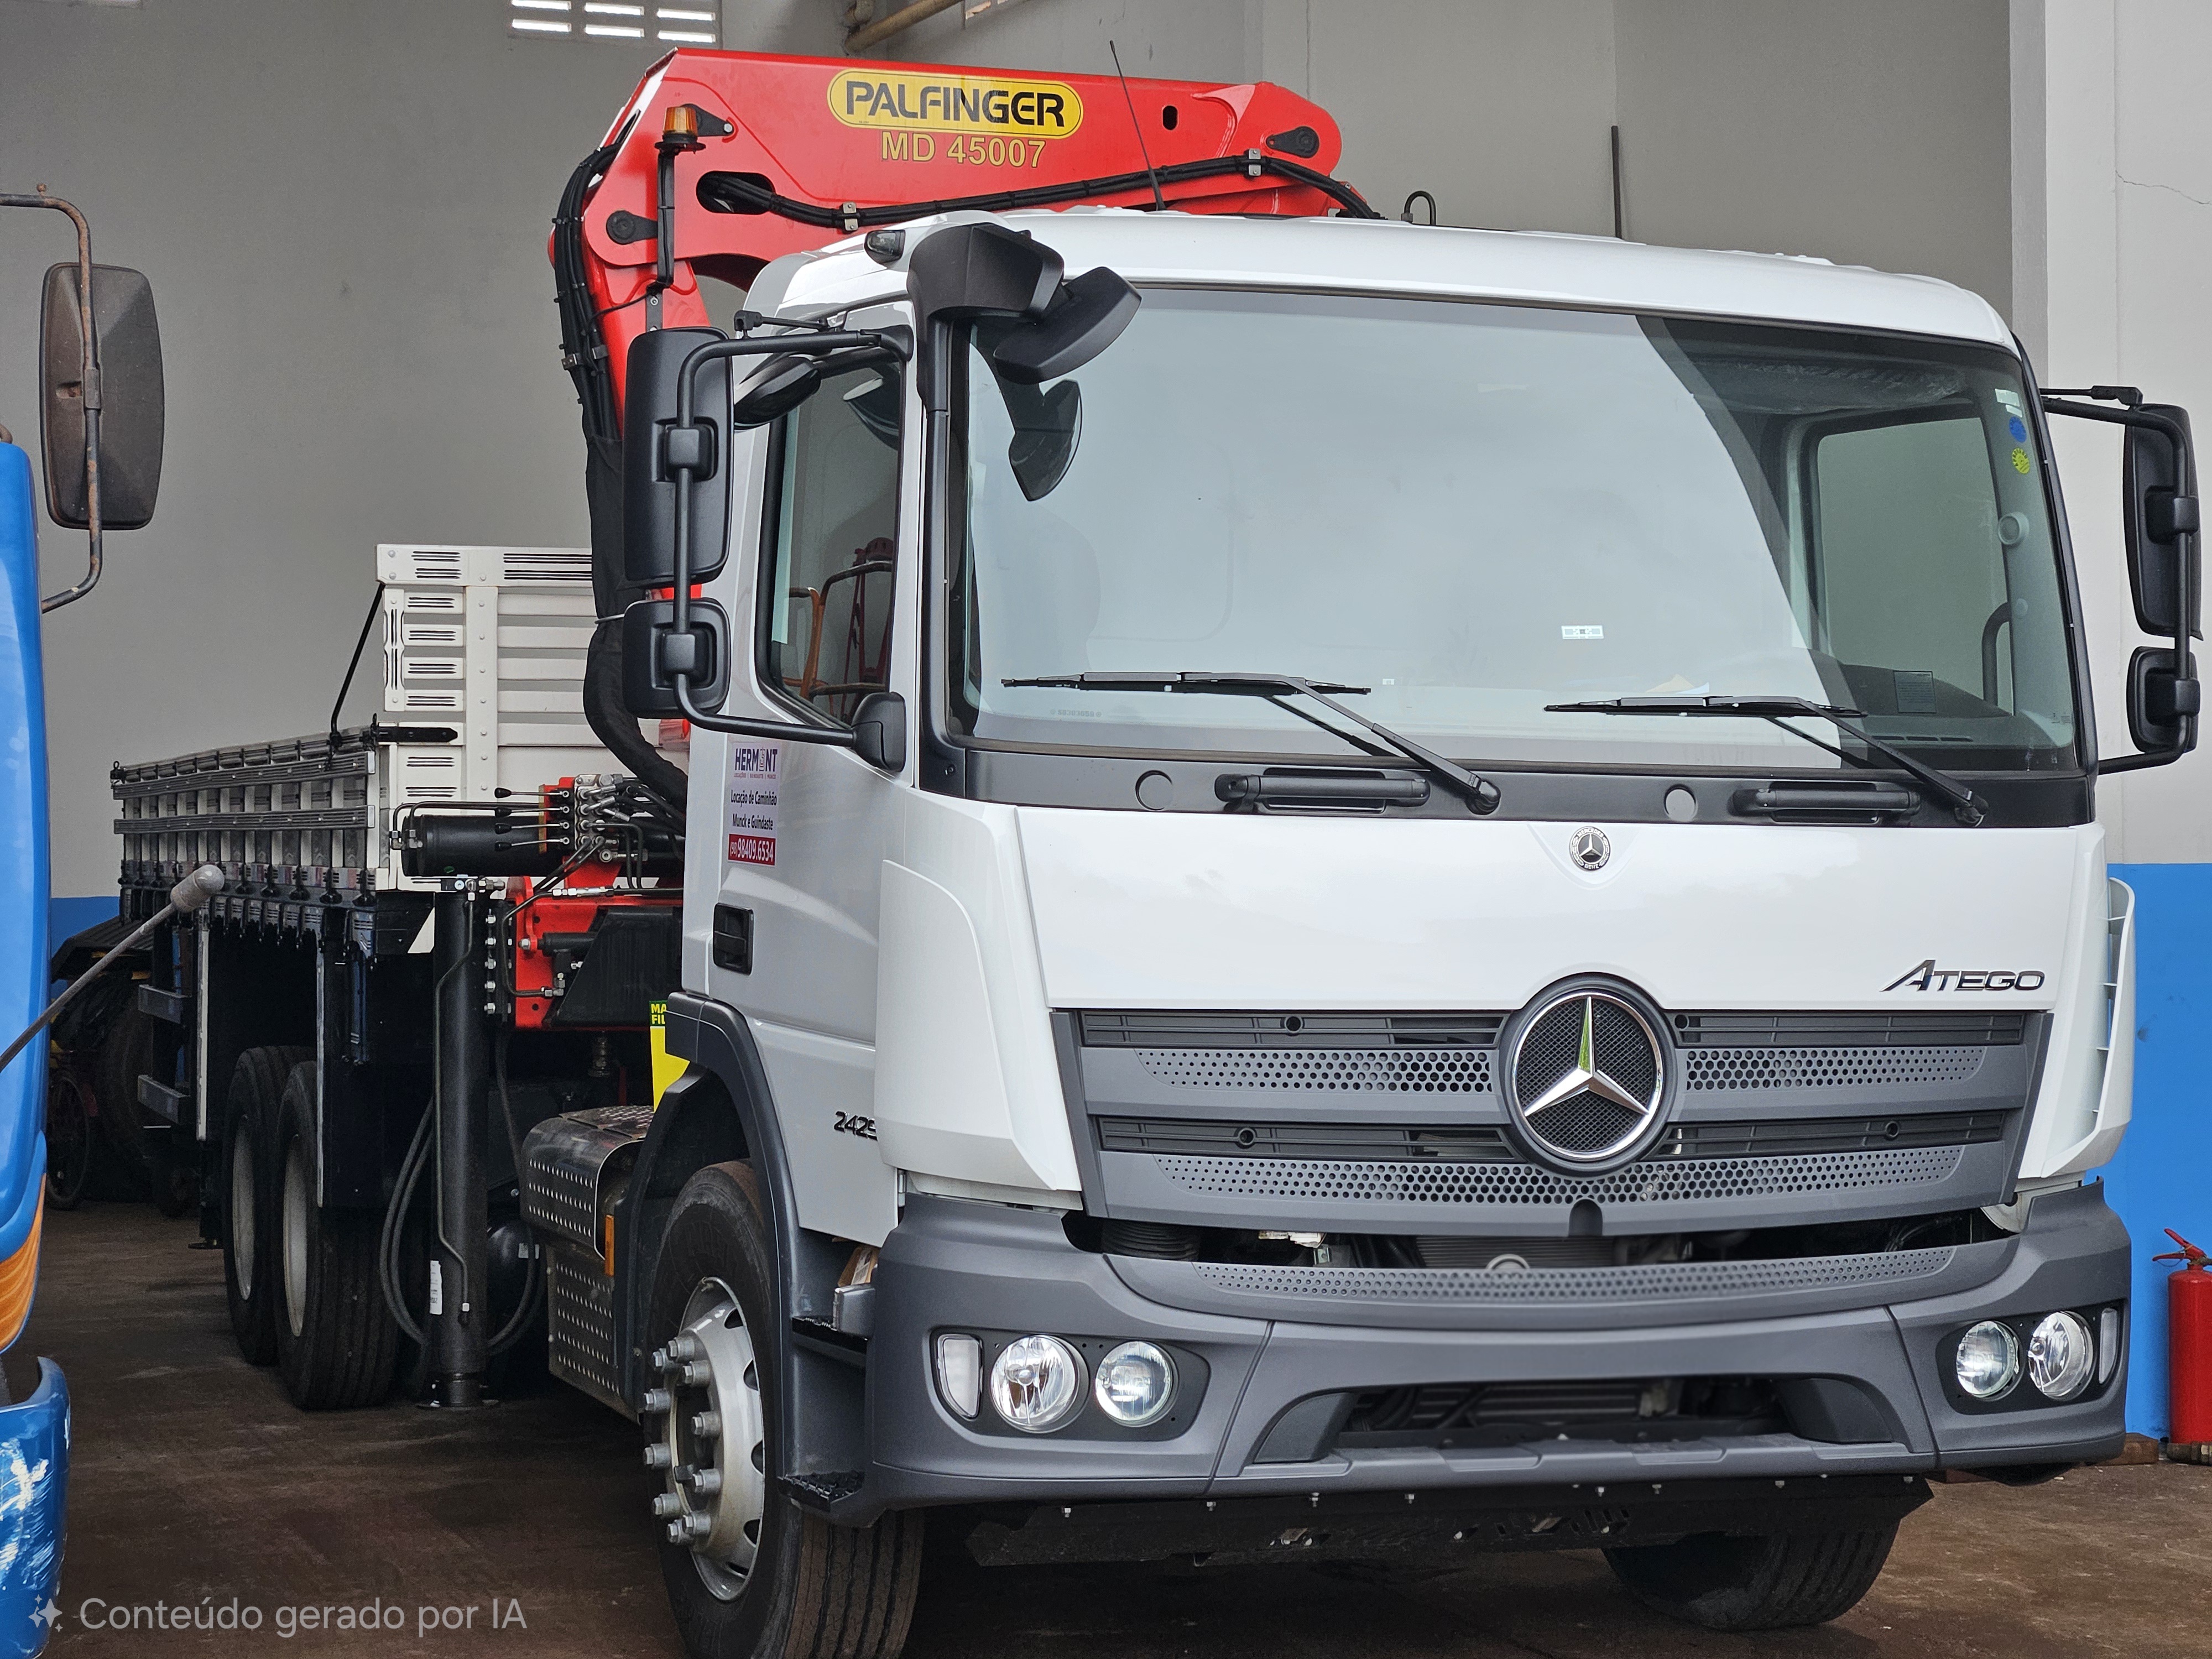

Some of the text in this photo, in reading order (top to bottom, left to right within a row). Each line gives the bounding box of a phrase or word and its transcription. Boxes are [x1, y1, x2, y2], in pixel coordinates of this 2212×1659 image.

[846, 80, 1065, 127] PALFINGER
[881, 131, 1046, 168] MD 45007
[734, 748, 778, 772] HERMONT
[731, 789, 777, 807] Locação de Caminhão
[732, 813, 773, 831] Munck e Guindaste
[1879, 959, 2045, 992] ATEGO
